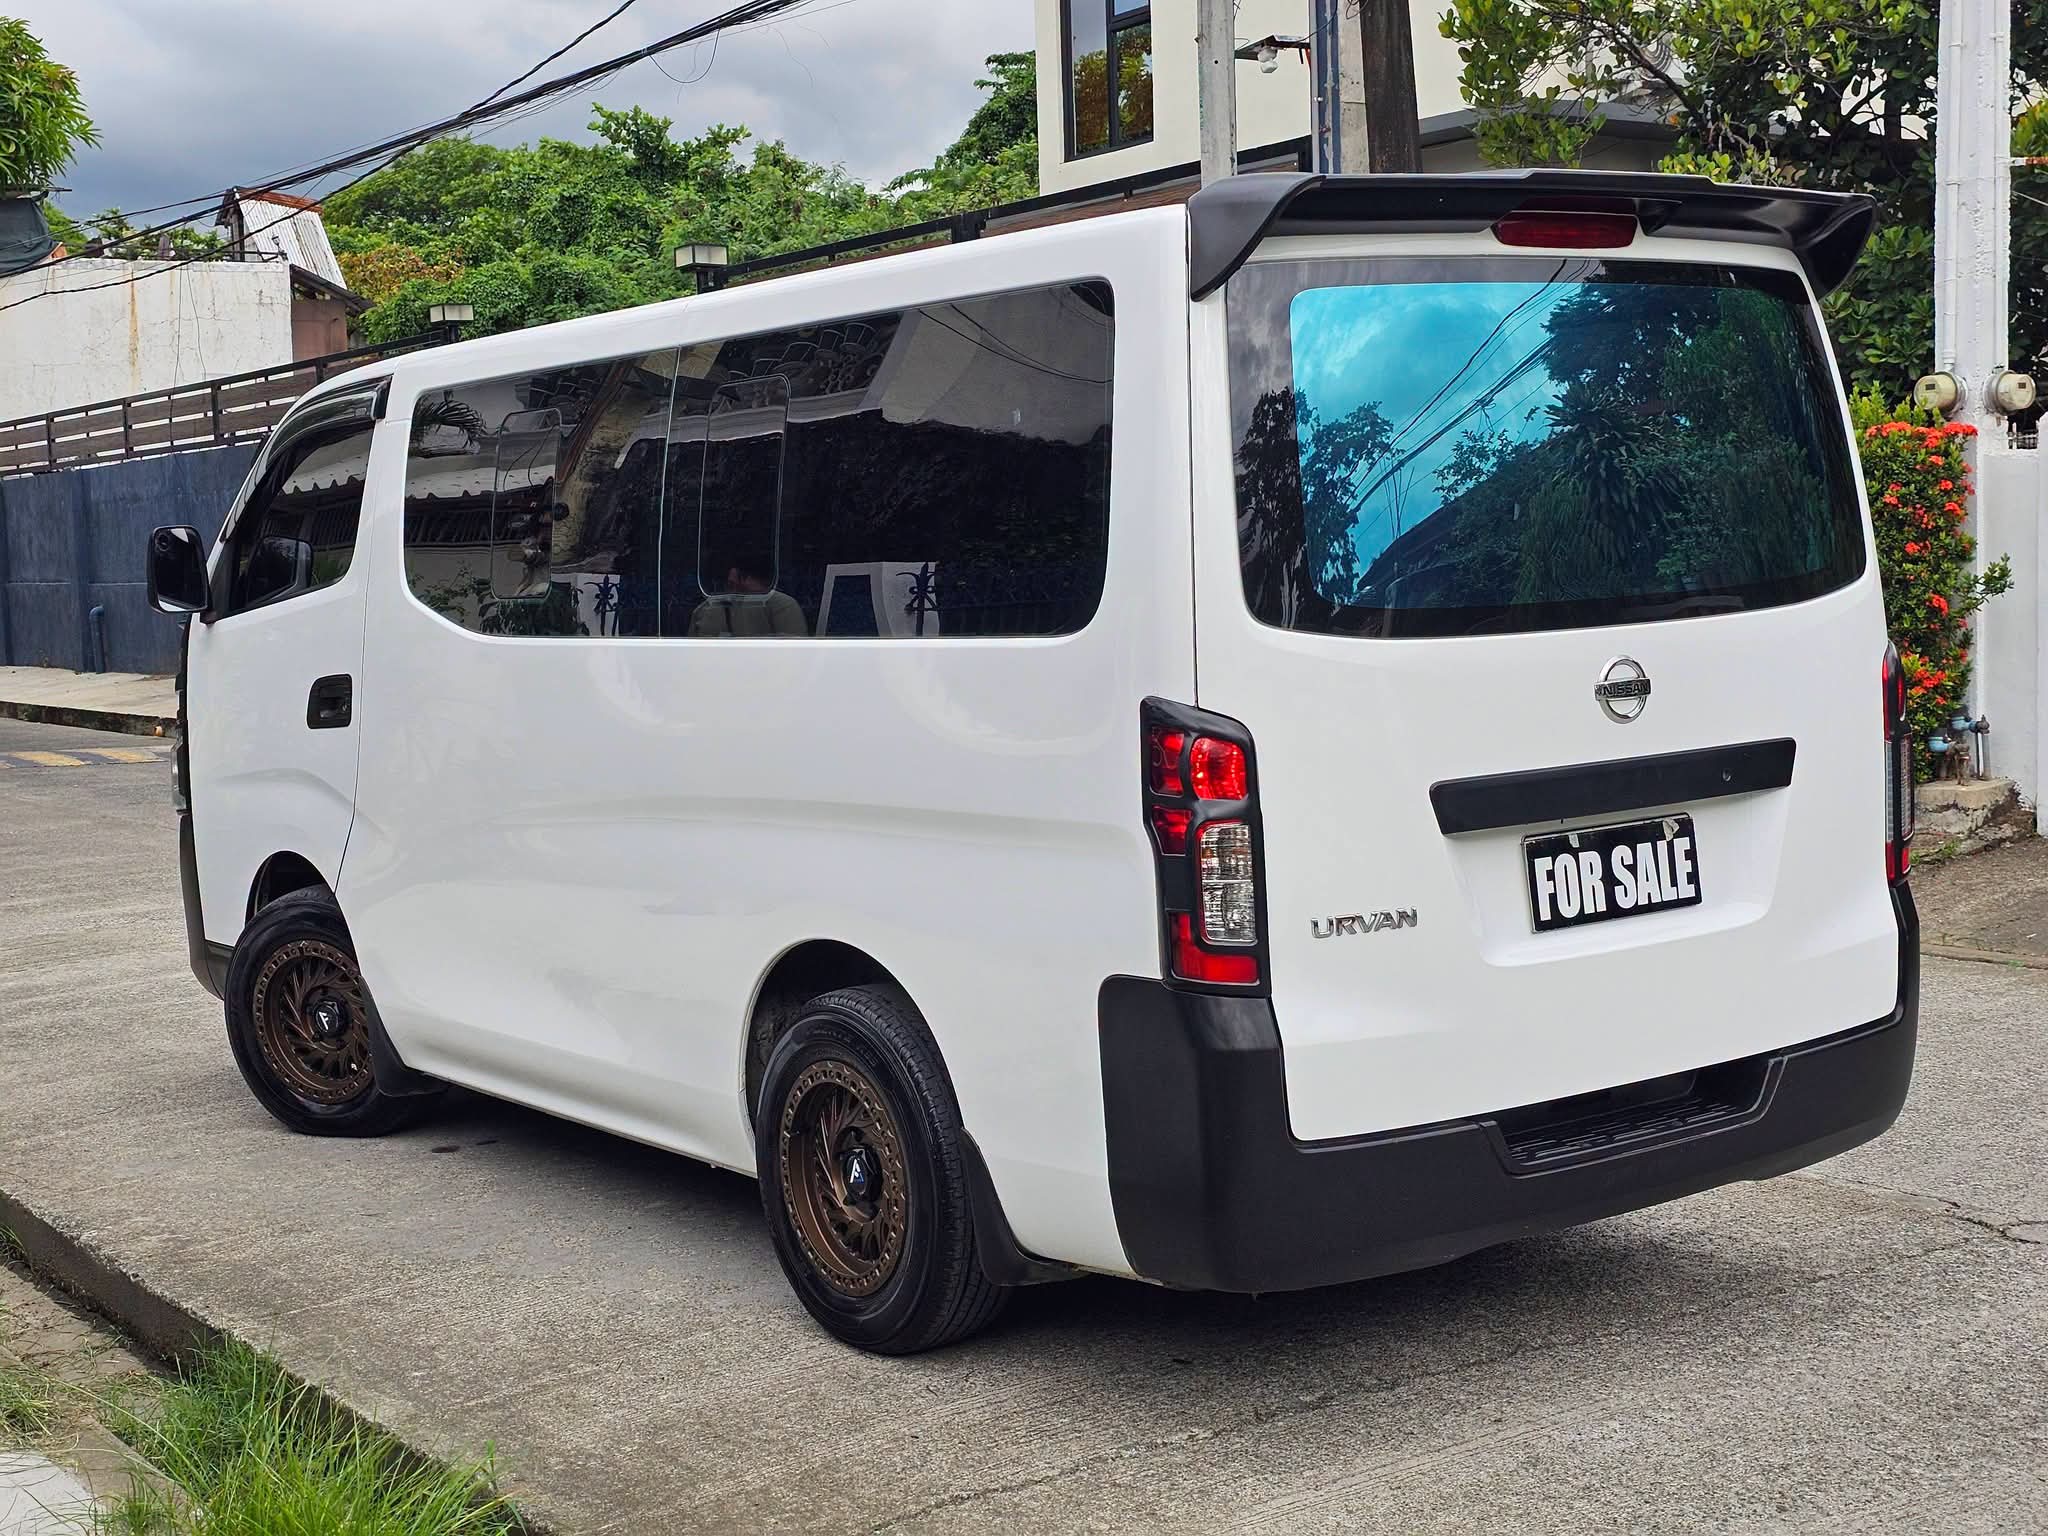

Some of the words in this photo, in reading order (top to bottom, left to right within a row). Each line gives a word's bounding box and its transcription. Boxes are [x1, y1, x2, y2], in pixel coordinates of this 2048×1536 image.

[1602, 682, 1648, 696] NISSAN
[1534, 850, 1607, 921] FOR
[1611, 837, 1696, 909] SALE
[1311, 906, 1418, 939] URVAN
